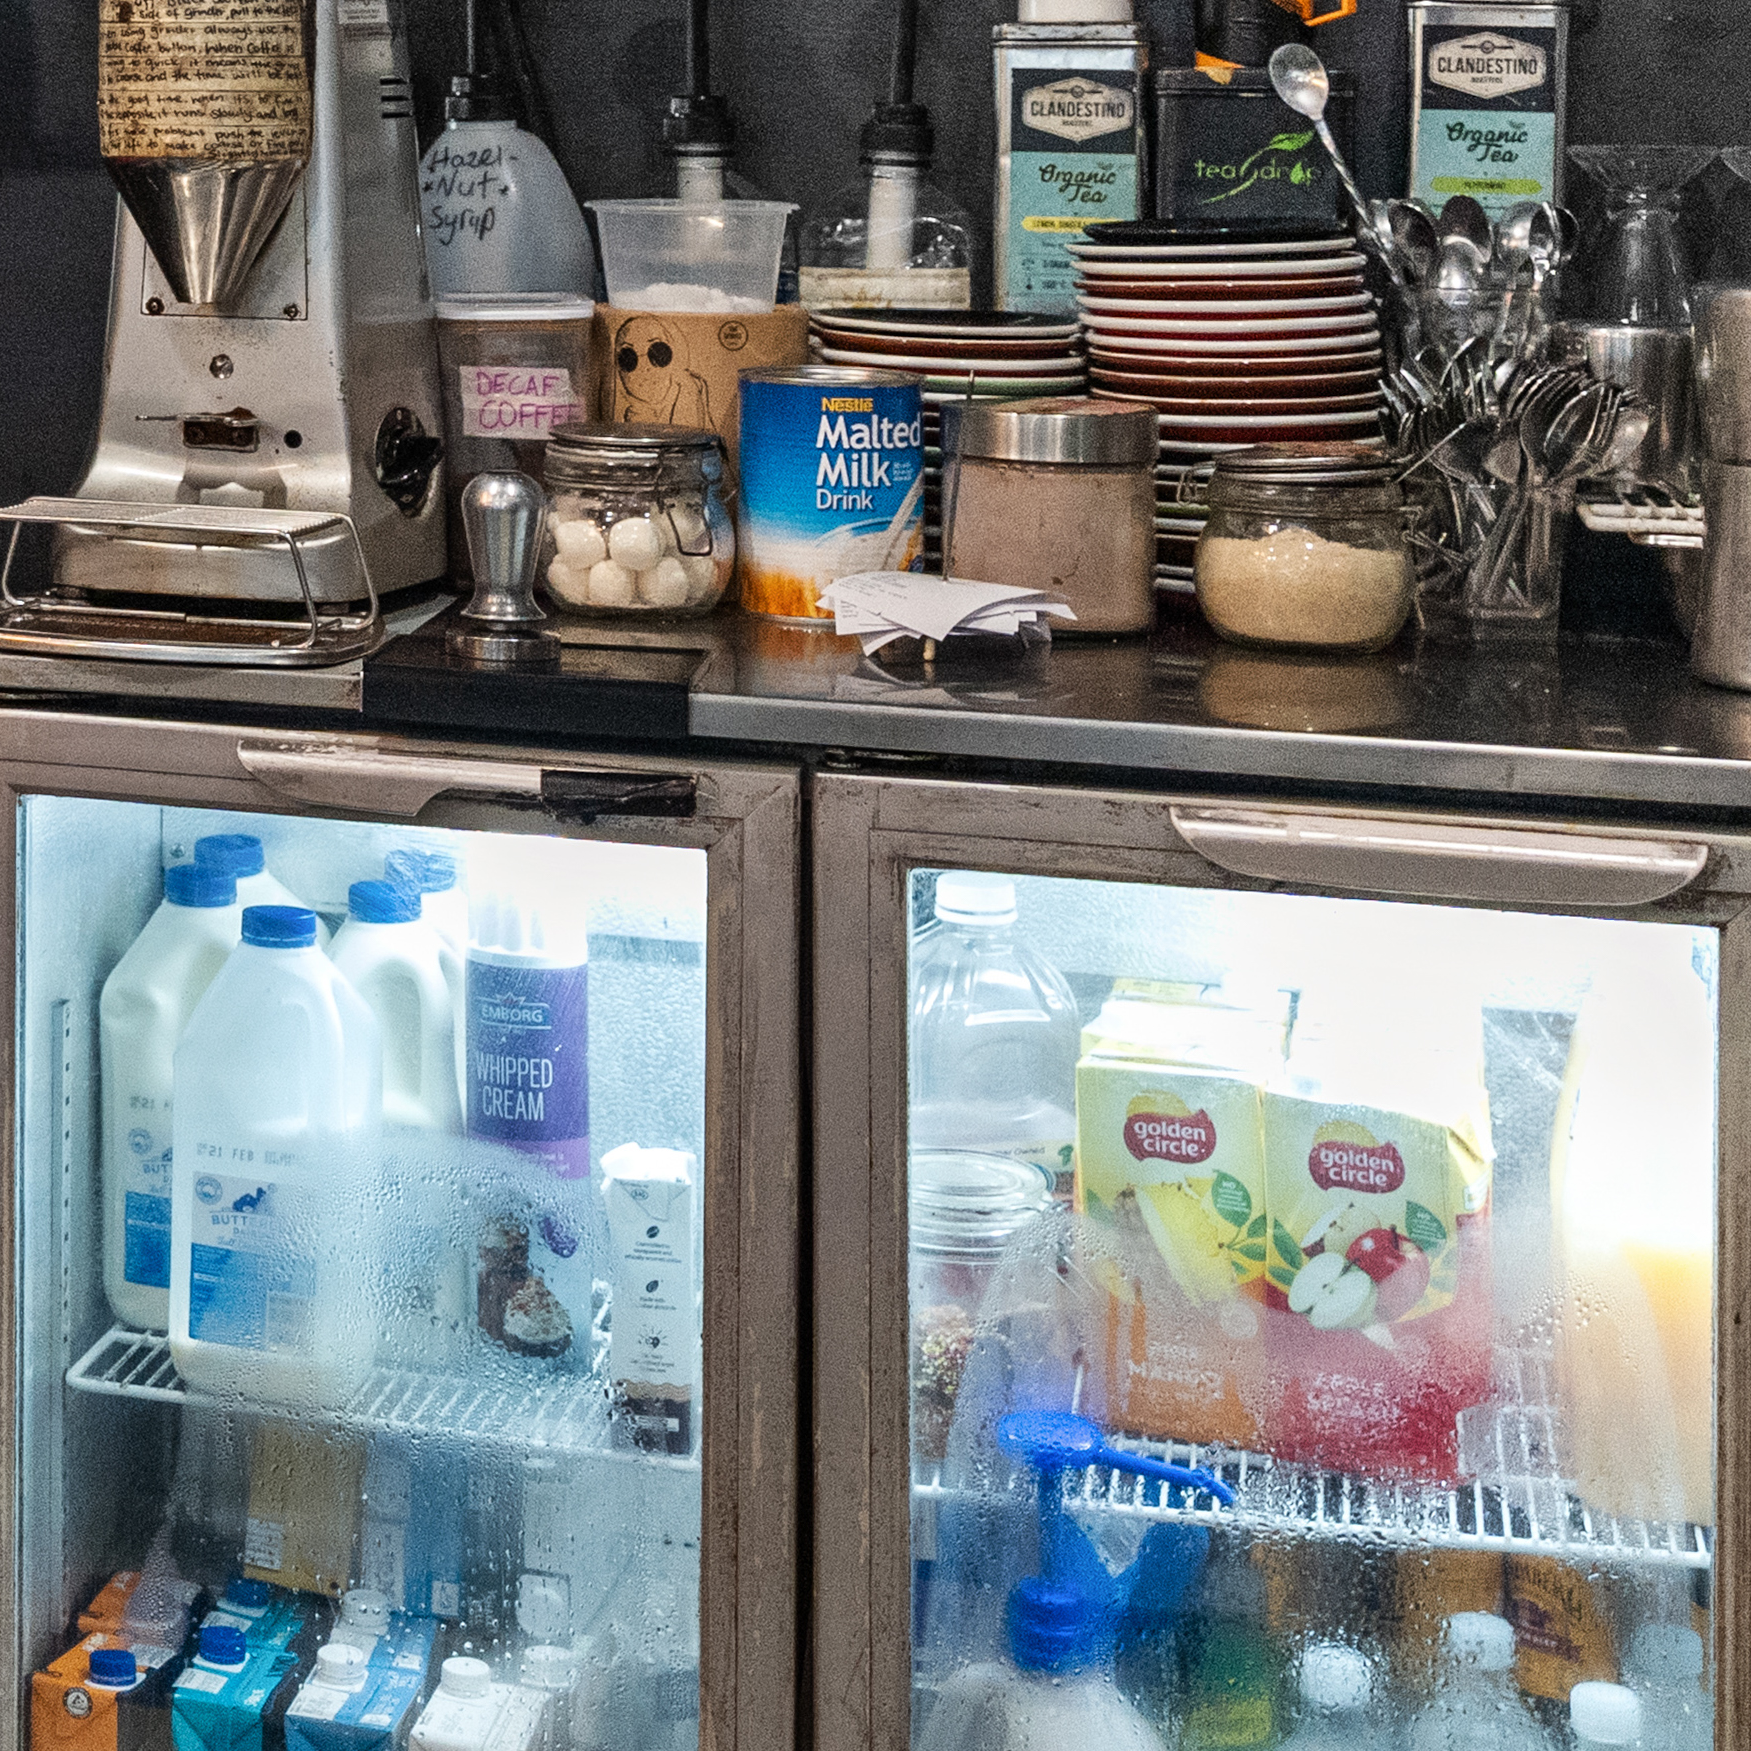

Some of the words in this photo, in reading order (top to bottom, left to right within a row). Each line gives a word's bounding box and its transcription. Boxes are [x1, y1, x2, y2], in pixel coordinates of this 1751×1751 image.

[1437, 56, 1538, 76] CLANDESTINO
[1030, 100, 1126, 119] CLANDESTINO
[1446, 122, 1528, 151] Organic
[1476, 144, 1520, 163] Tea
[1038, 163, 1117, 192] Organic
[1066, 183, 1108, 204] Tea
[428, 205, 496, 246] Syrup
[476, 371, 560, 397] DECAF
[478, 403, 586, 430] COFFEE
[816, 412, 921, 449] Malted
[816, 452, 891, 488] Milk
[816, 488, 874, 511] Drink
[482, 1005, 543, 1023] EMBORG
[476, 1052, 553, 1089] WHIPPED
[482, 1085, 544, 1121] CREAM
[1133, 1121, 1208, 1143] golden
[232, 1148, 254, 1162] FEB
[1142, 1136, 1199, 1157] circle
[1318, 1148, 1395, 1172] golden
[1327, 1163, 1388, 1187] circle
